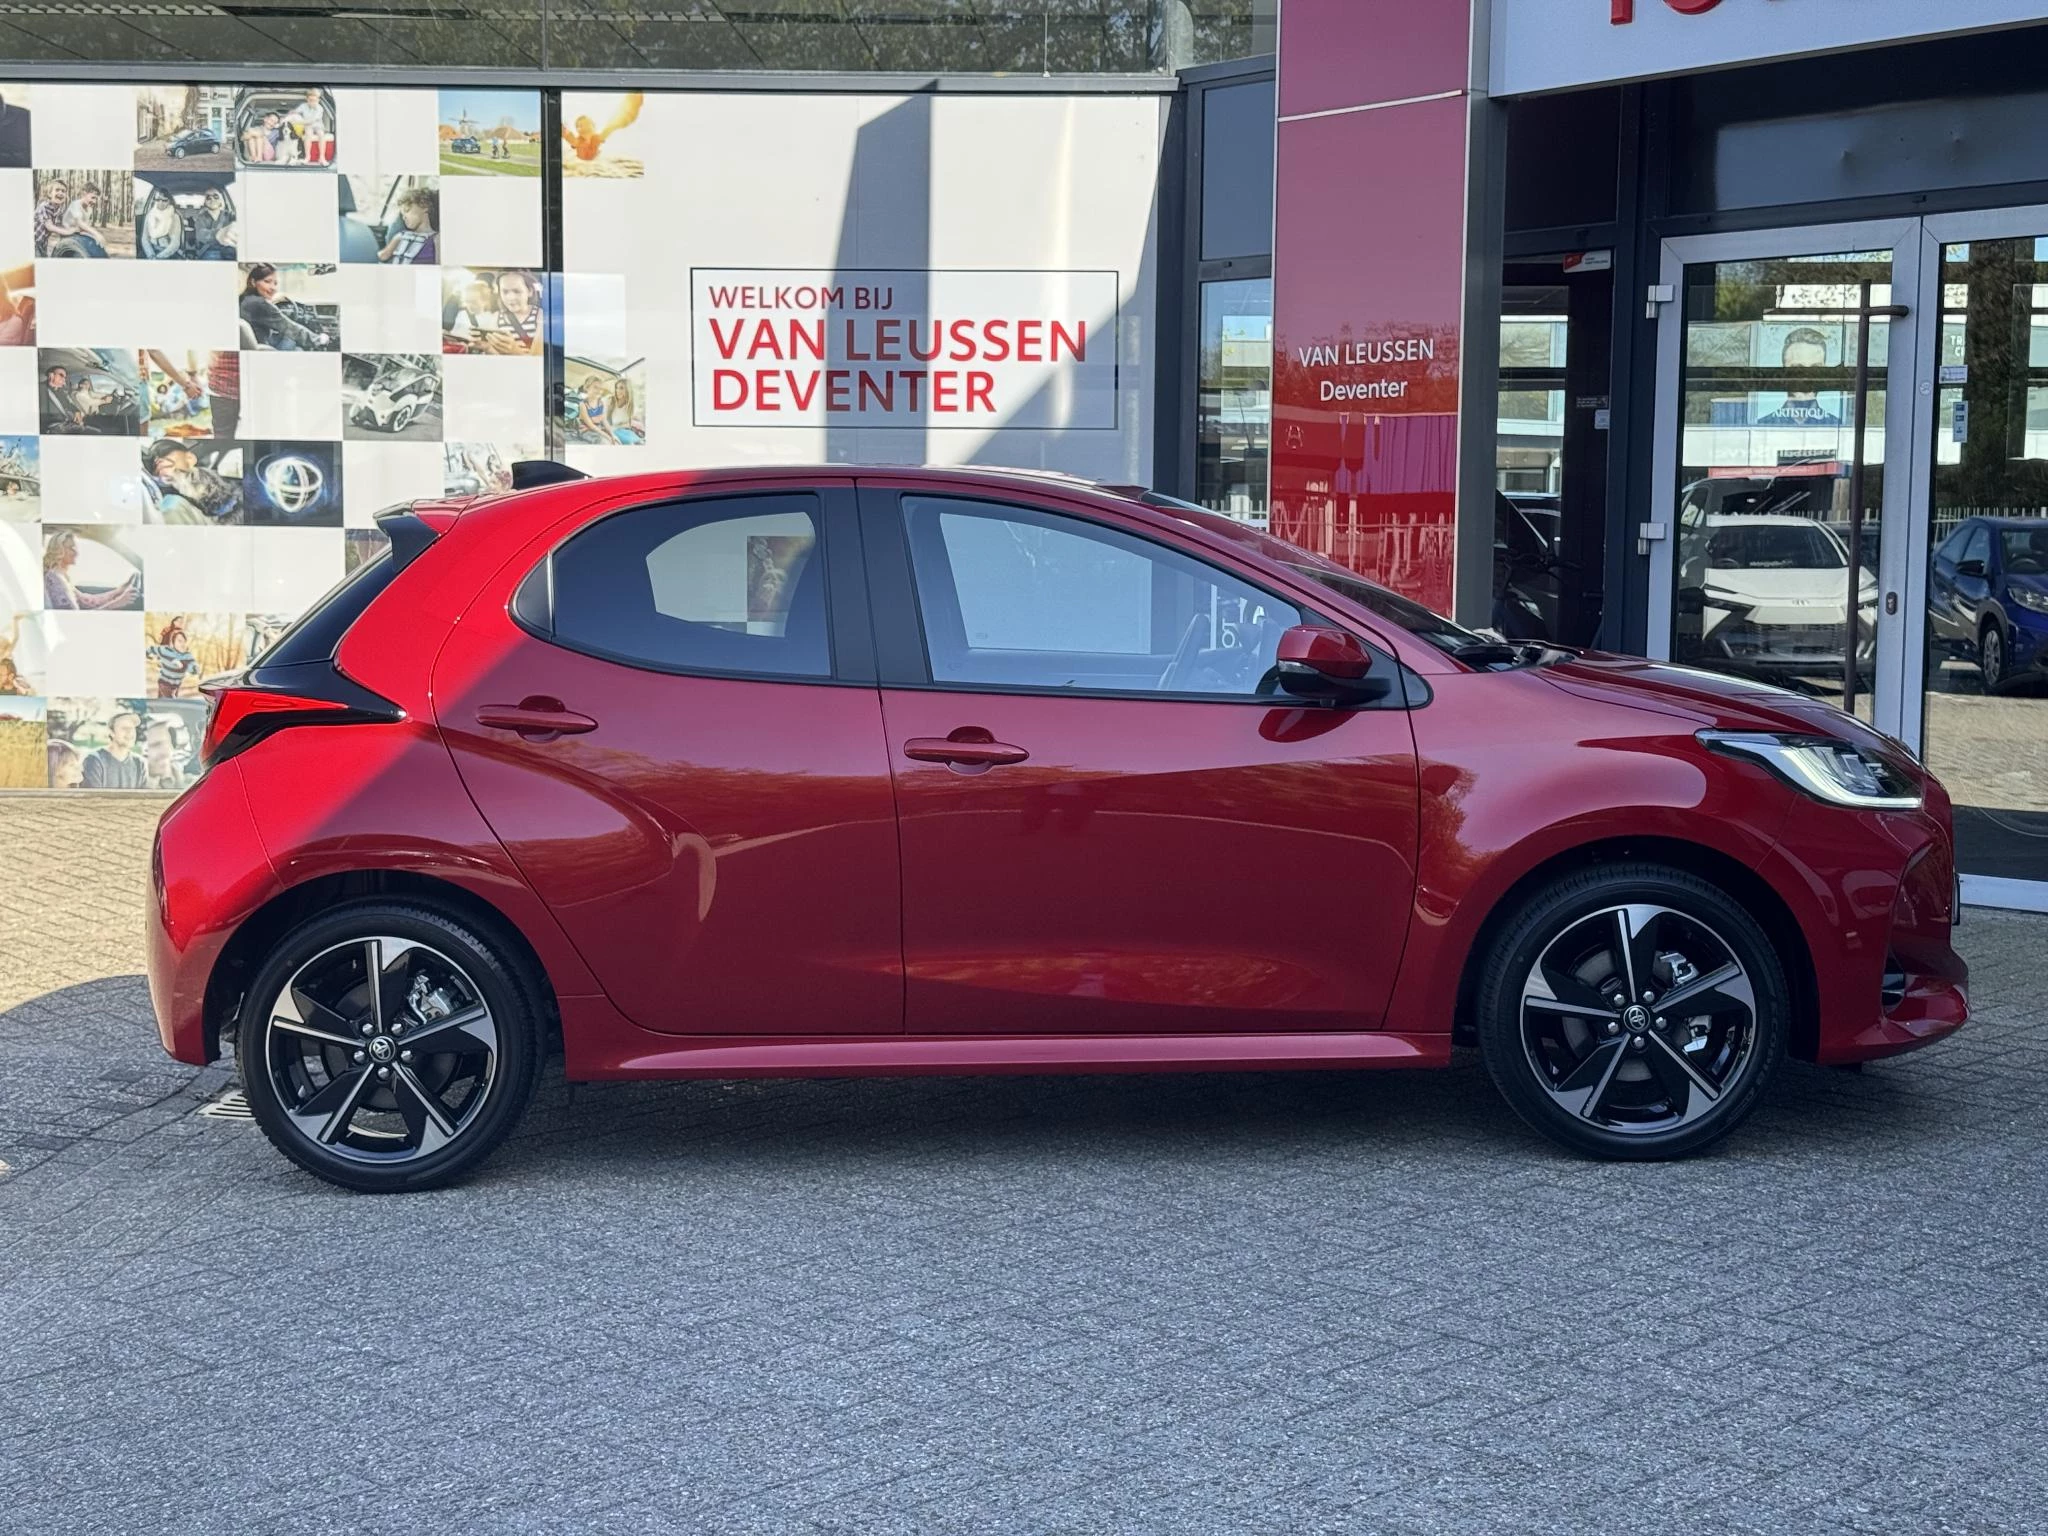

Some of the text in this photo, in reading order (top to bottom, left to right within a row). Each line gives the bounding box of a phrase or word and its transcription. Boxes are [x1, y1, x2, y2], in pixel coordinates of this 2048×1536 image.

[709, 286, 894, 310] WELKOM BIJ
[709, 318, 1087, 362] VAN LEUSSEN
[1298, 338, 1434, 367] VAN LEUSSEN
[712, 368, 998, 413] DEVENTER
[1320, 379, 1408, 401] Deventer
